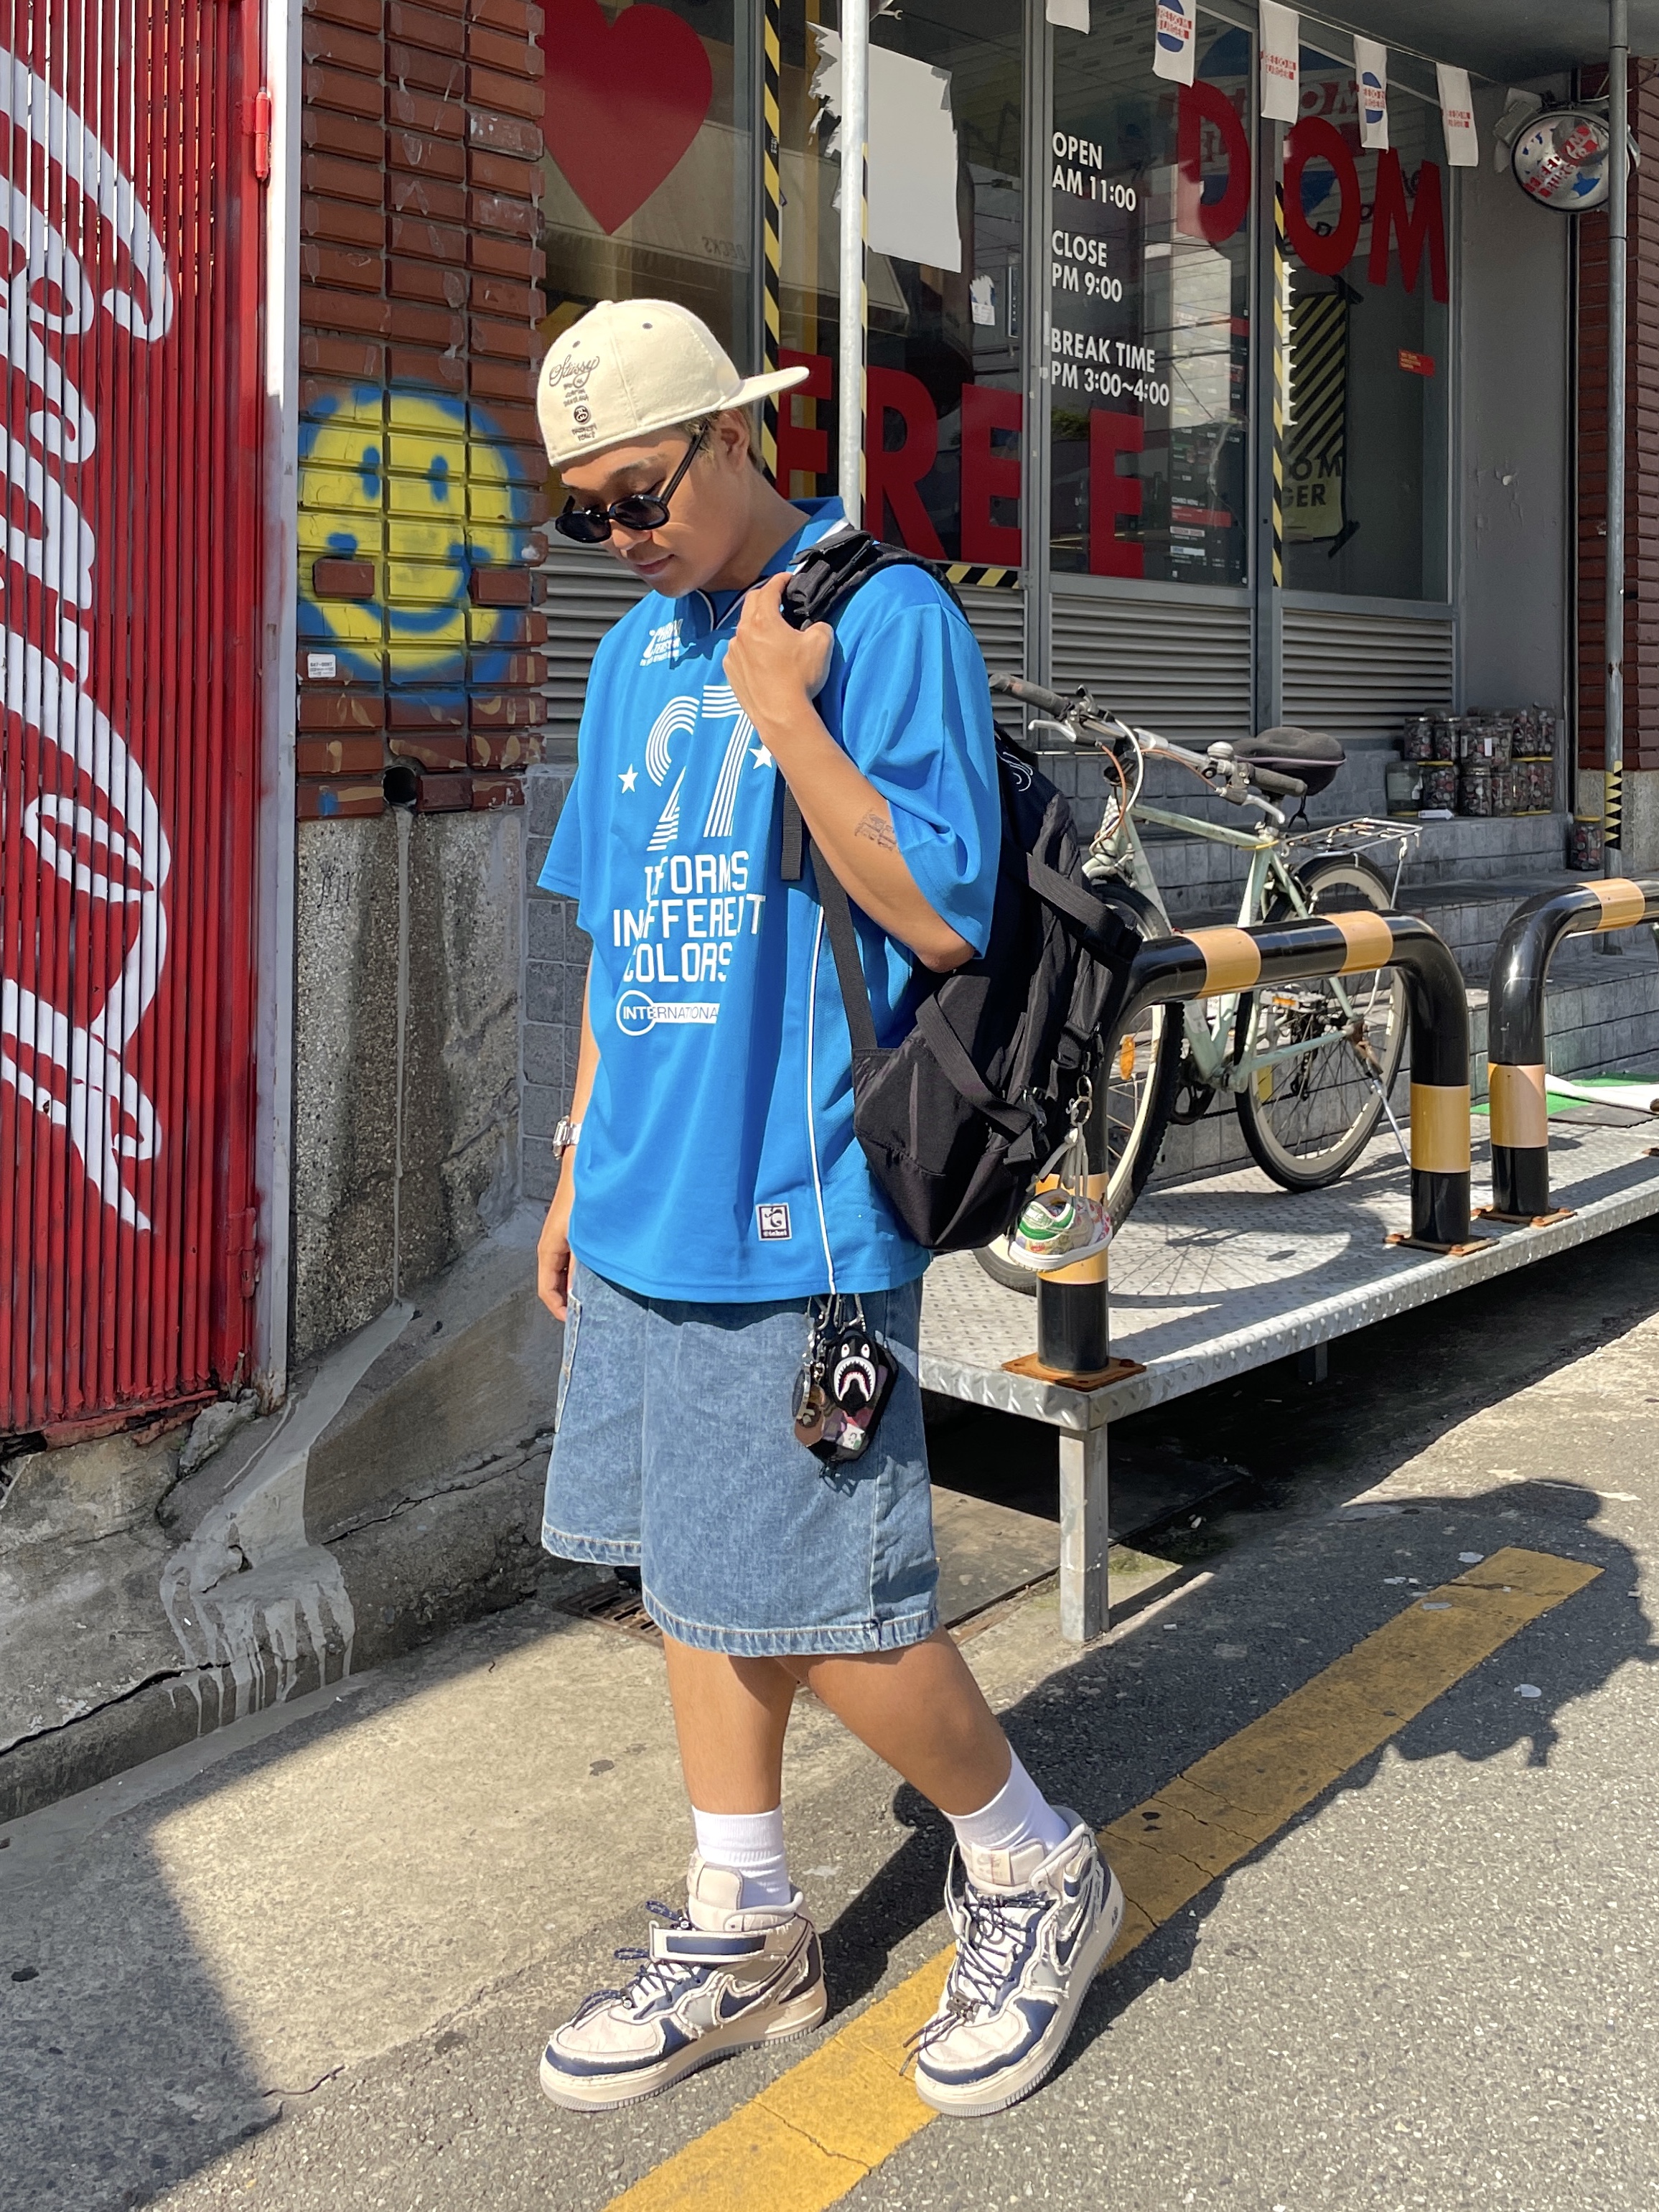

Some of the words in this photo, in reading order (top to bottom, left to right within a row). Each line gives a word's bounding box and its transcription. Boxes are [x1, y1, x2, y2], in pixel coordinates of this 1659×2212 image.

[1052, 131, 1102, 169] OPEN
[1052, 165, 1083, 196] AM
[1090, 176, 1136, 211] 11:00
[1052, 230, 1108, 268] CLOSE
[1052, 263, 1079, 292] PM
[1085, 272, 1123, 302] 9:00
[1052, 328, 1111, 364] BREAK
[1116, 342, 1155, 373] TIME
[1052, 360, 1078, 390] PM
[1084, 368, 1169, 406] 3:00~4:00
[645, 685, 754, 851] 27
